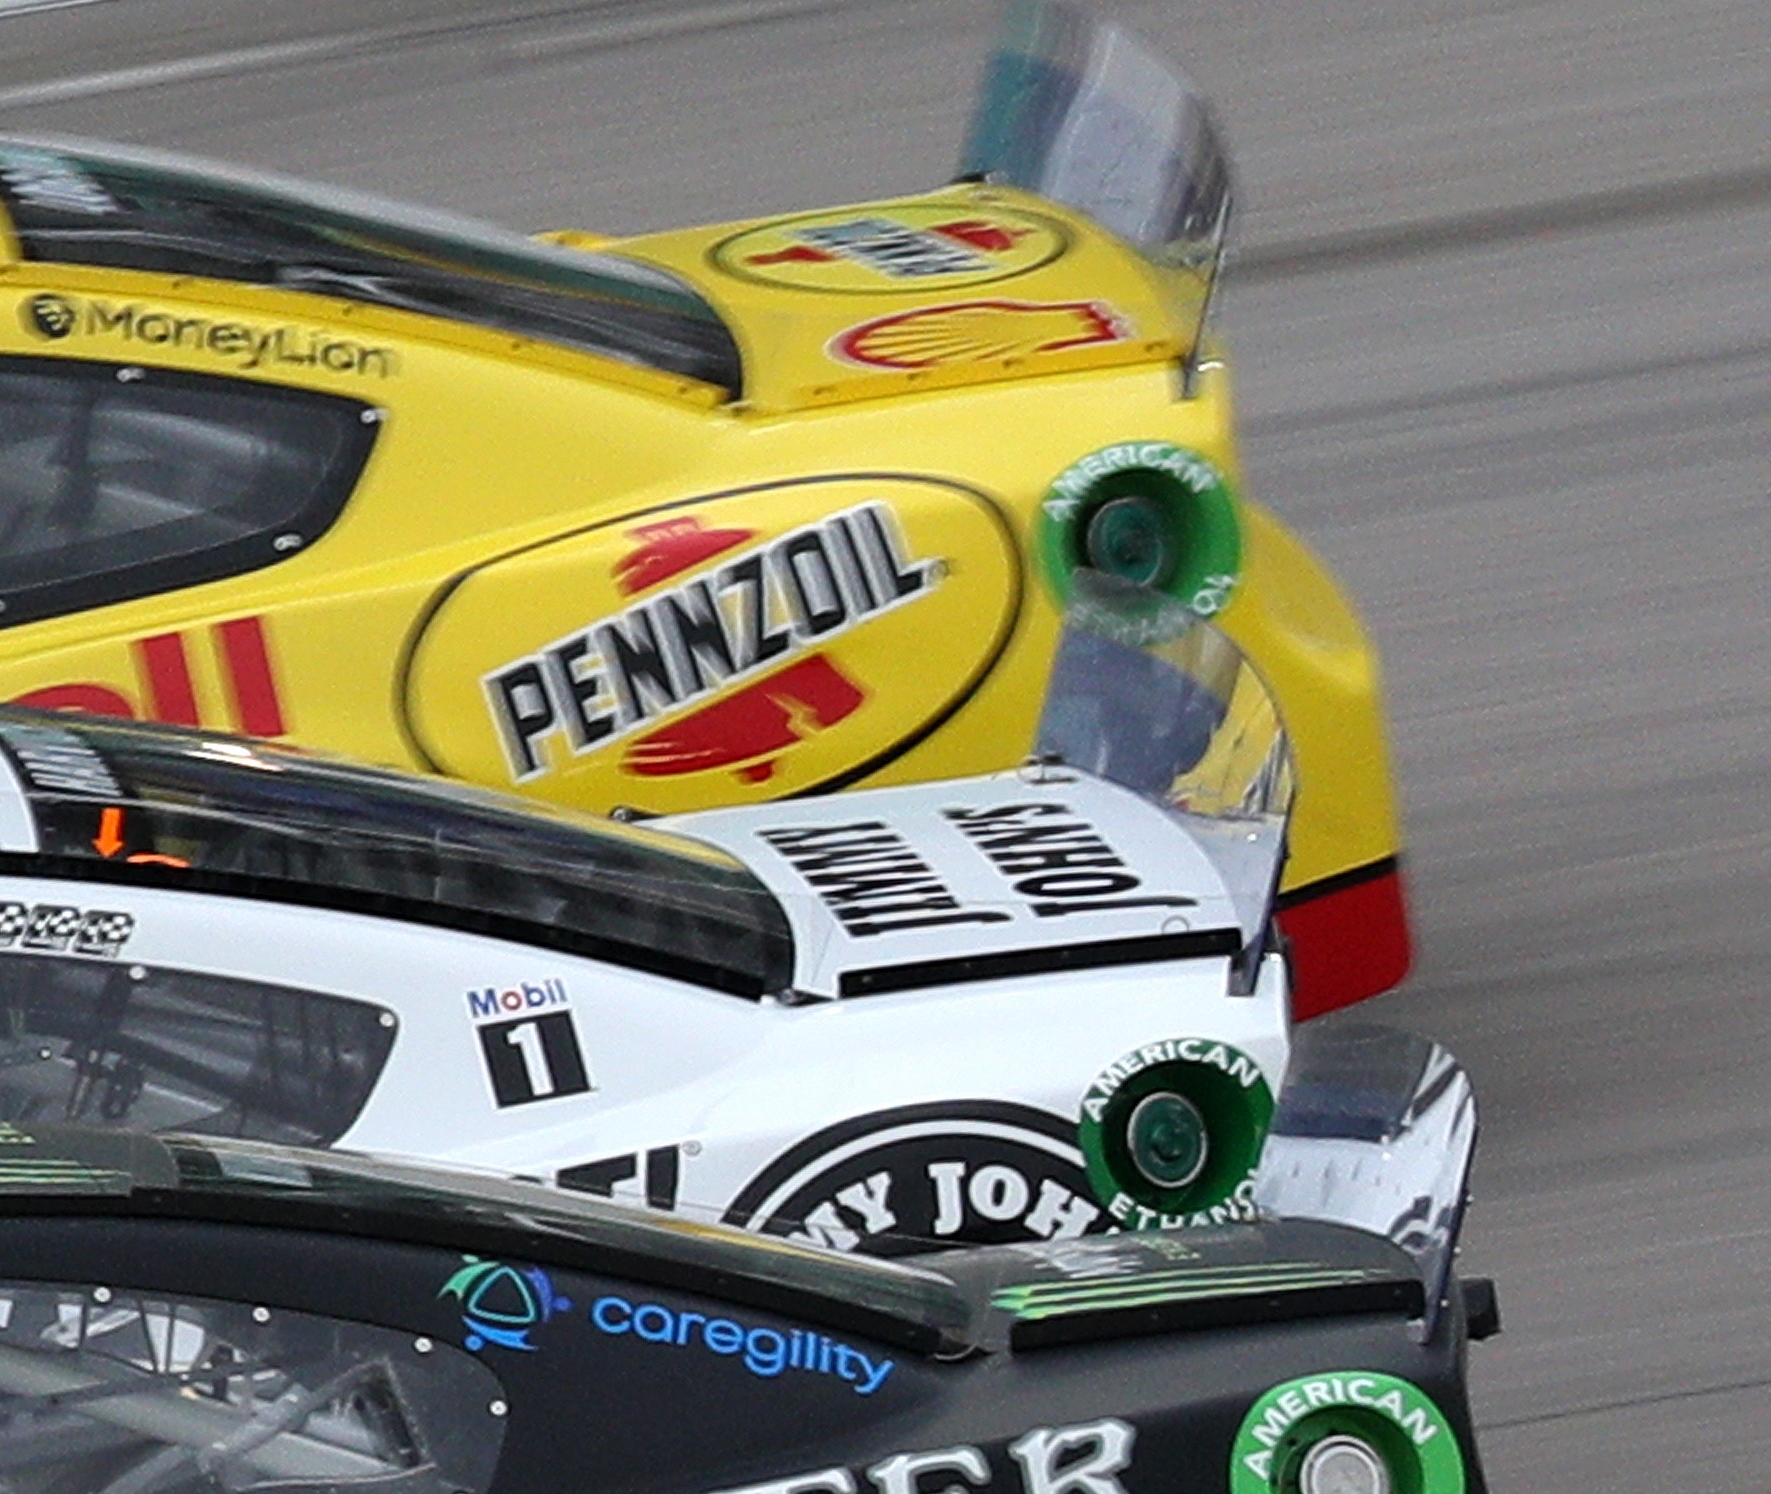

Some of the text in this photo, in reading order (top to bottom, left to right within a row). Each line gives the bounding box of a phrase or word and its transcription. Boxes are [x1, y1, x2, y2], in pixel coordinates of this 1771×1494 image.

[84, 305, 400, 380] MoneyLion
[1042, 442, 1223, 521] AMERICAN
[489, 505, 927, 775] PENNZOIL
[467, 979, 567, 1018] Mobil
[506, 1023, 552, 1095] 1
[1084, 1040, 1259, 1123] AMERICAN
[591, 1295, 893, 1393] caregility
[1243, 1378, 1438, 1480] AMERICAN
